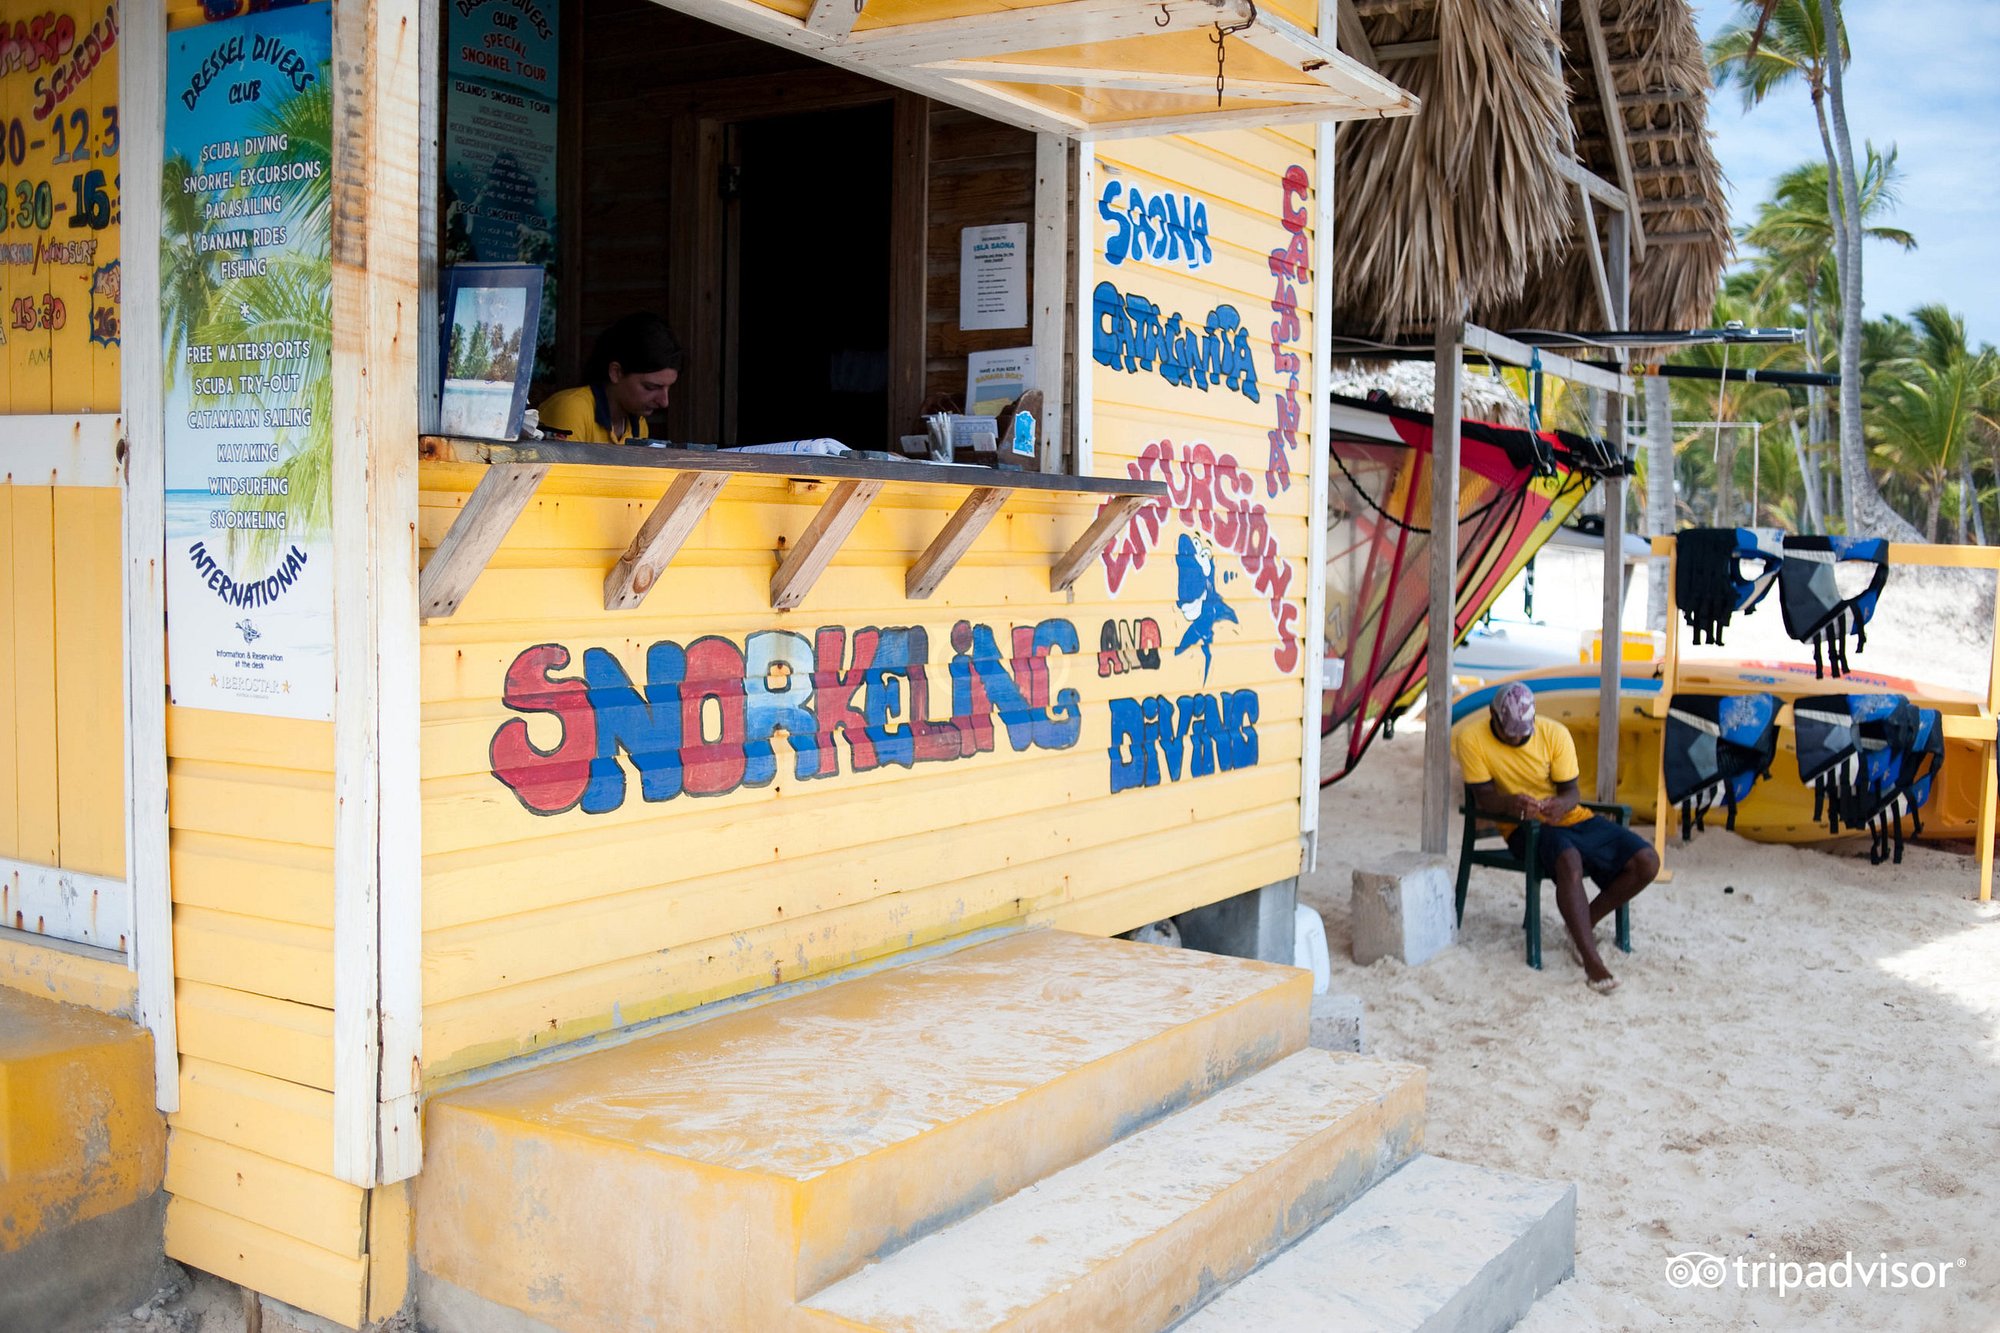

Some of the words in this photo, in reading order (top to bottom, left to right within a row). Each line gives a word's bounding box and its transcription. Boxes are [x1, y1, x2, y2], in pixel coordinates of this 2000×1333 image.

[493, 11, 519, 30] CLUB
[484, 34, 528, 59] SPECIAL
[182, 35, 245, 111] DRESSEL
[252, 33, 315, 92] DIVERS
[462, 47, 511, 72] SNORKEL
[516, 61, 547, 80] TOUR
[229, 79, 261, 104] CLUB
[455, 81, 487, 98] ISLANDS
[491, 91, 525, 108] SNORKEL
[530, 100, 551, 114] TOUR
[201, 141, 240, 162] SCUBA
[245, 134, 288, 157] DIVING
[183, 171, 235, 194] SNORKEL
[240, 161, 321, 187] EXCURSIONS
[206, 195, 281, 220] PARASAILING
[487, 207, 521, 221] SNORKEL
[1098, 180, 1212, 269] SAONA
[201, 231, 248, 252] BANANA
[253, 226, 287, 247] RIDES
[974, 243, 989, 252] ISLA
[991, 242, 1015, 250] SAONA
[221, 258, 266, 279] FISHING
[12, 293, 66, 331] 15:30
[187, 345, 213, 364] FREE
[217, 340, 310, 362] WATERSPORTS
[195, 377, 234, 395] SCUBA
[239, 374, 299, 394] TRY-OUT
[187, 409, 259, 429] CATAMARAN
[263, 408, 311, 427] SAILING
[217, 443, 278, 462] KAYAKING
[208, 477, 288, 496] WINDSURFING
[210, 511, 286, 530] SNORKELING
[189, 541, 308, 610] INTERNATIONAL
[216, 649, 245, 659] Information
[252, 651, 283, 661] Reservation
[242, 660, 251, 669] the
[252, 661, 264, 670] desk
[222, 675, 280, 694] IBEROSTAR
[489, 618, 1081, 817] SNORKELING
[1097, 617, 1162, 678] AND
[1108, 689, 1260, 795] DIVING
